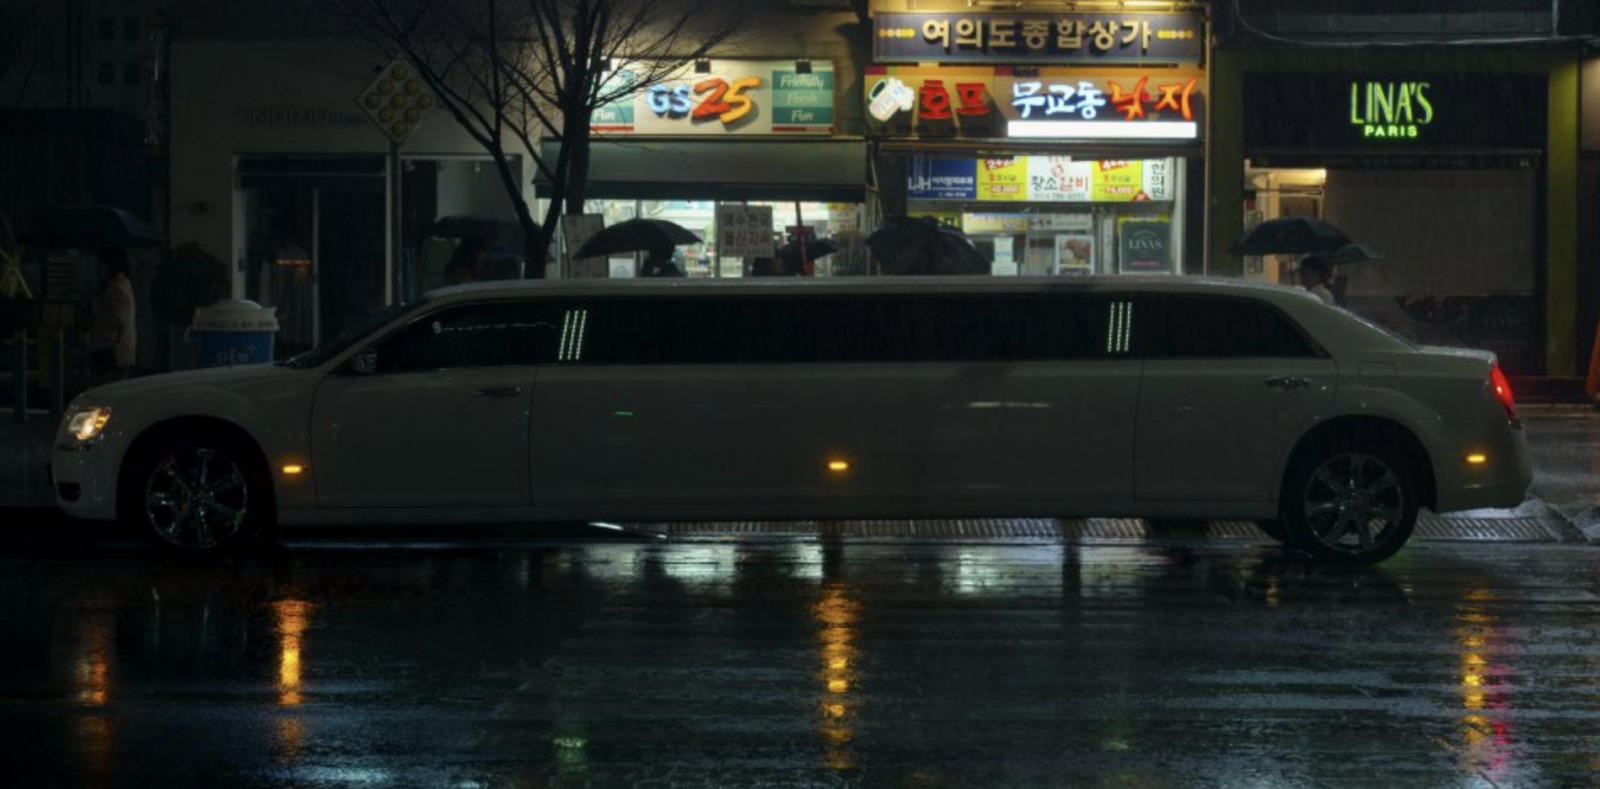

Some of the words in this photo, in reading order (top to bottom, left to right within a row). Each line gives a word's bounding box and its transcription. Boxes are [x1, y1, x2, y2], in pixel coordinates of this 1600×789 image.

[922, 19, 1151, 49] 여의도종합상가
[780, 73, 825, 92] Friendly
[1012, 81, 1106, 119] 무교동
[1107, 75, 1197, 120] 낙지
[647, 75, 762, 124] GS25
[918, 79, 990, 119] 호프
[1351, 82, 1433, 124] LINA'S
[592, 109, 615, 121] Fun
[791, 109, 814, 123] Fun
[1365, 125, 1418, 137] PARIS
